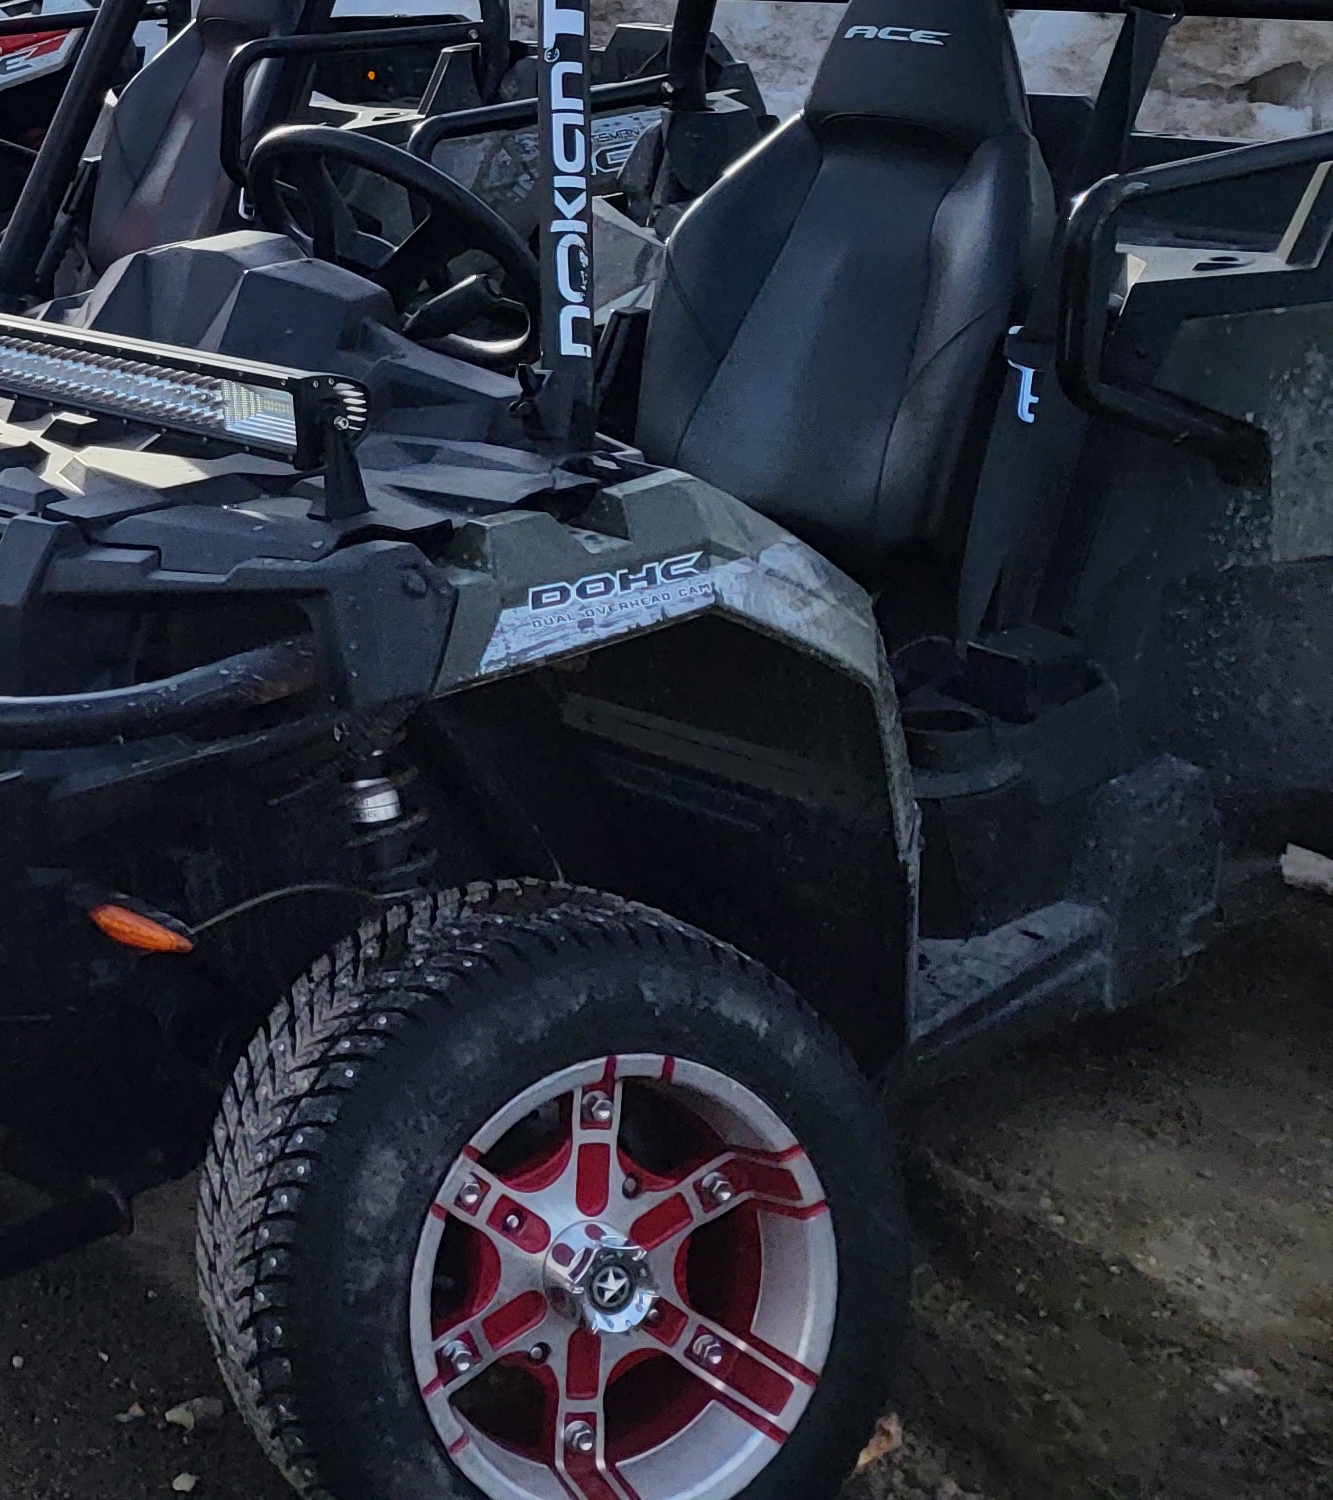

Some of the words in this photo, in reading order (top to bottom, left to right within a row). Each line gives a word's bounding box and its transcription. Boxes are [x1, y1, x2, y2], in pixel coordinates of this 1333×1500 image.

[844, 25, 952, 46] ACE
[528, 551, 704, 613] DOHC
[532, 612, 576, 629] DUAL
[584, 592, 670, 618] OVERHEAD
[677, 583, 710, 598] CAM
